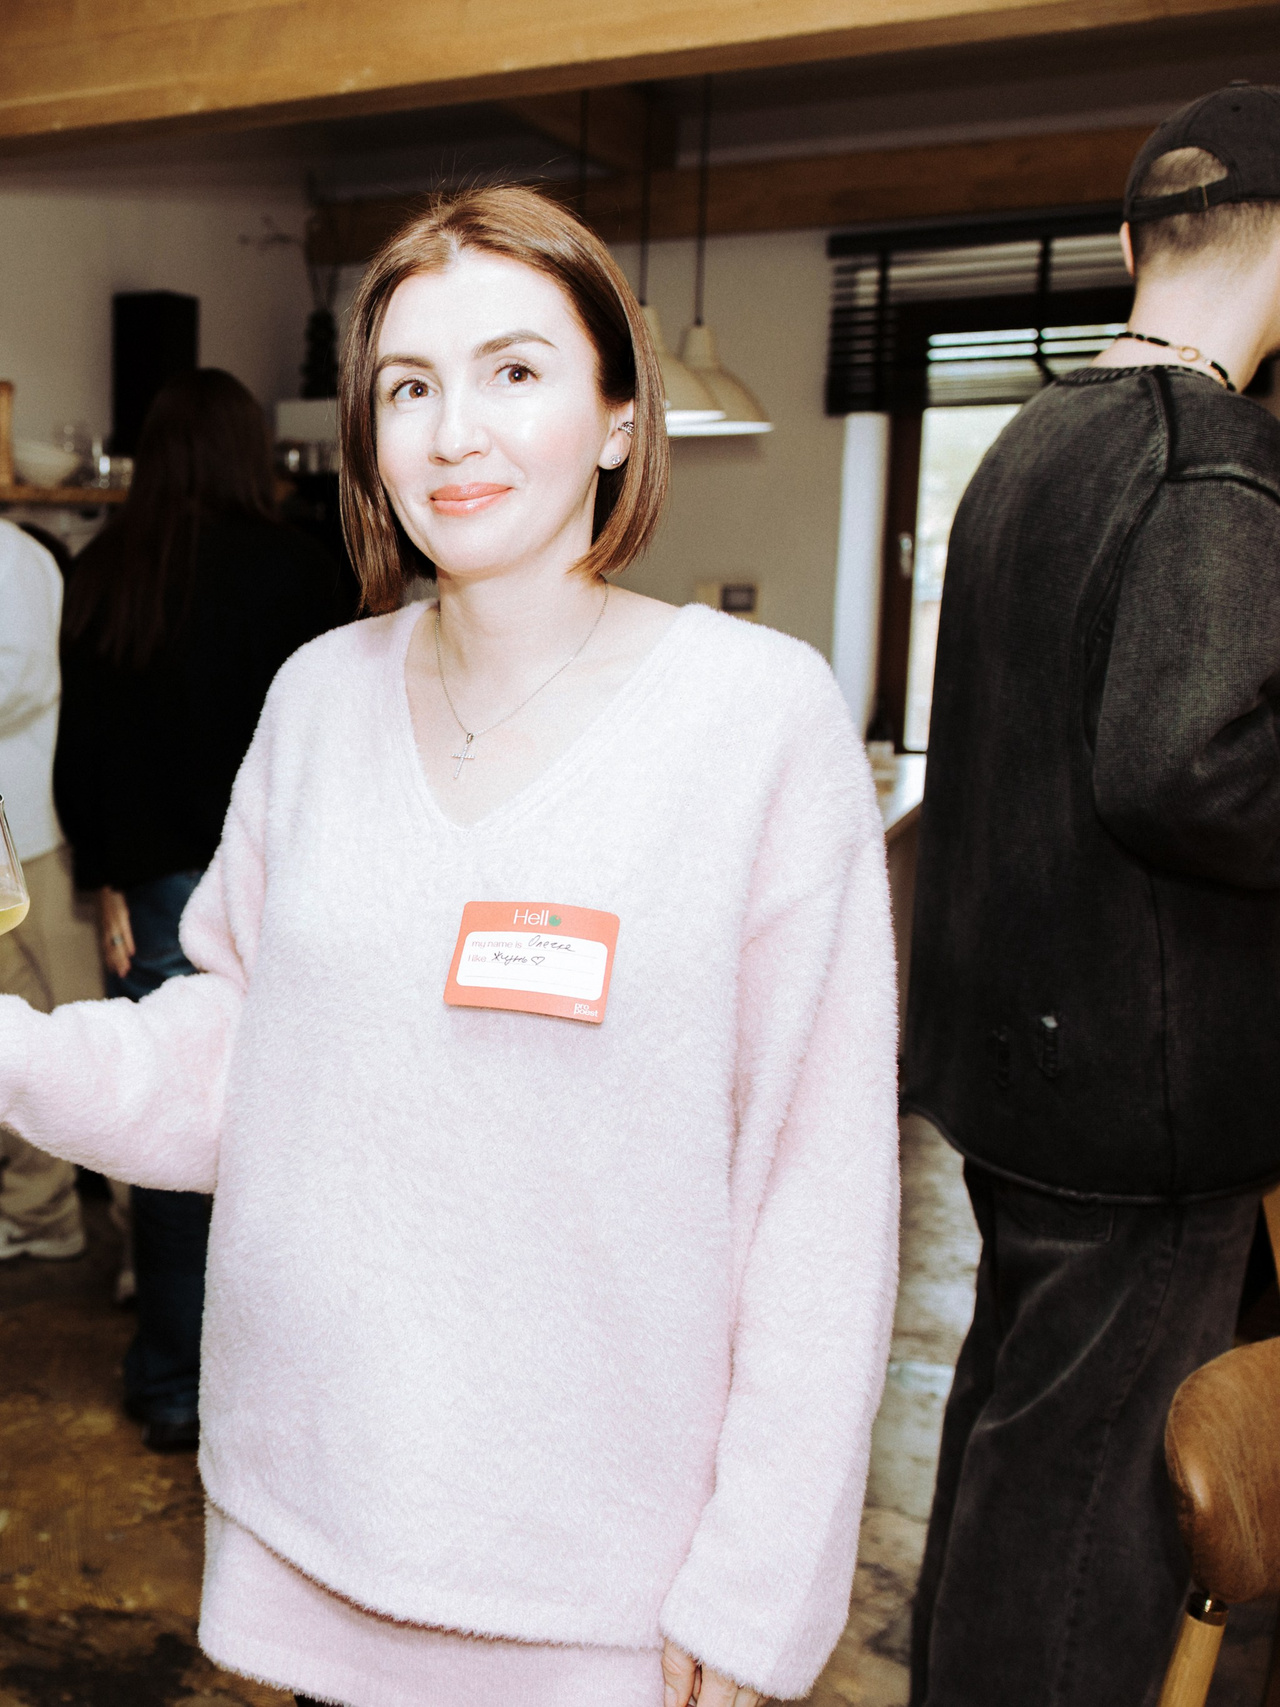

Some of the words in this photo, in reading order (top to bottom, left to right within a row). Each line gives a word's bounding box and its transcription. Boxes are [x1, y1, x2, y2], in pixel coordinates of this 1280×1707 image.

[472, 941, 486, 949] my
[487, 941, 513, 949] name
[515, 940, 522, 948] is
